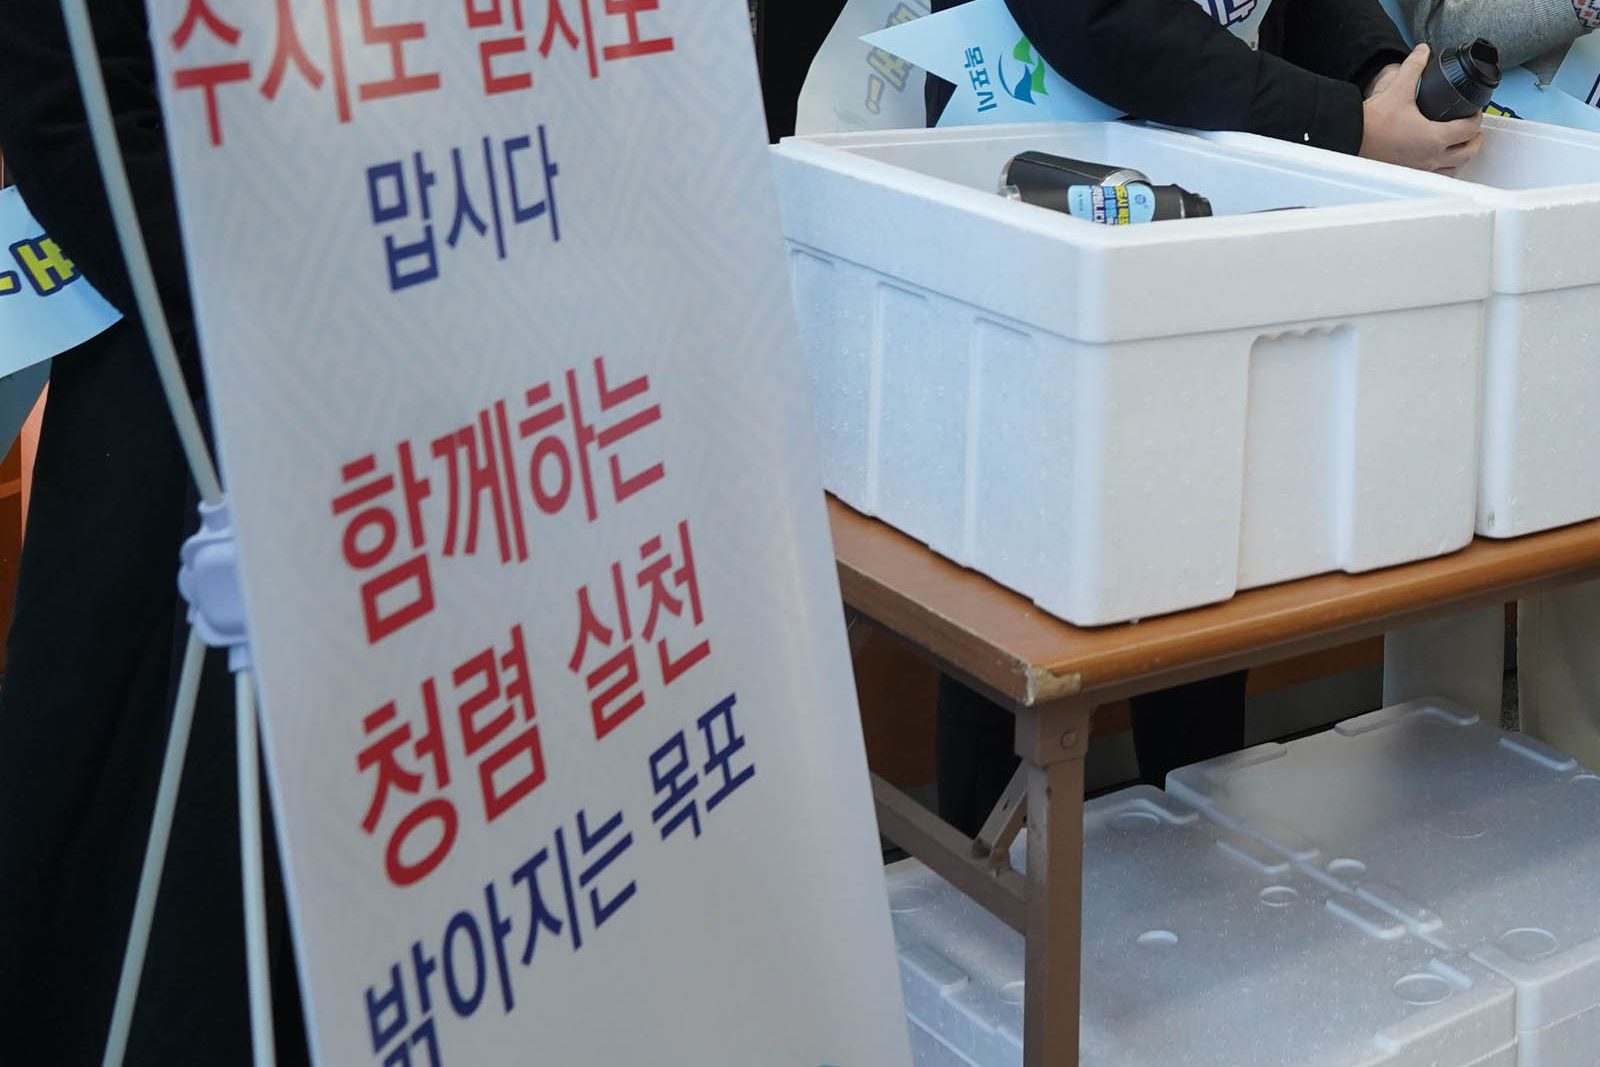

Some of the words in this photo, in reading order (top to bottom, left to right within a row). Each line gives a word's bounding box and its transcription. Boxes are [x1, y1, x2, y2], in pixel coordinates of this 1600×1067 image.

[365, 124, 562, 294] 맙시다
[964, 45, 997, 113] 목포시
[330, 355, 666, 646] 함께하는
[355, 622, 548, 890] 청렴
[566, 520, 712, 742] 실천
[364, 807, 639, 1067] 밝아지는
[648, 691, 757, 843] 목포
